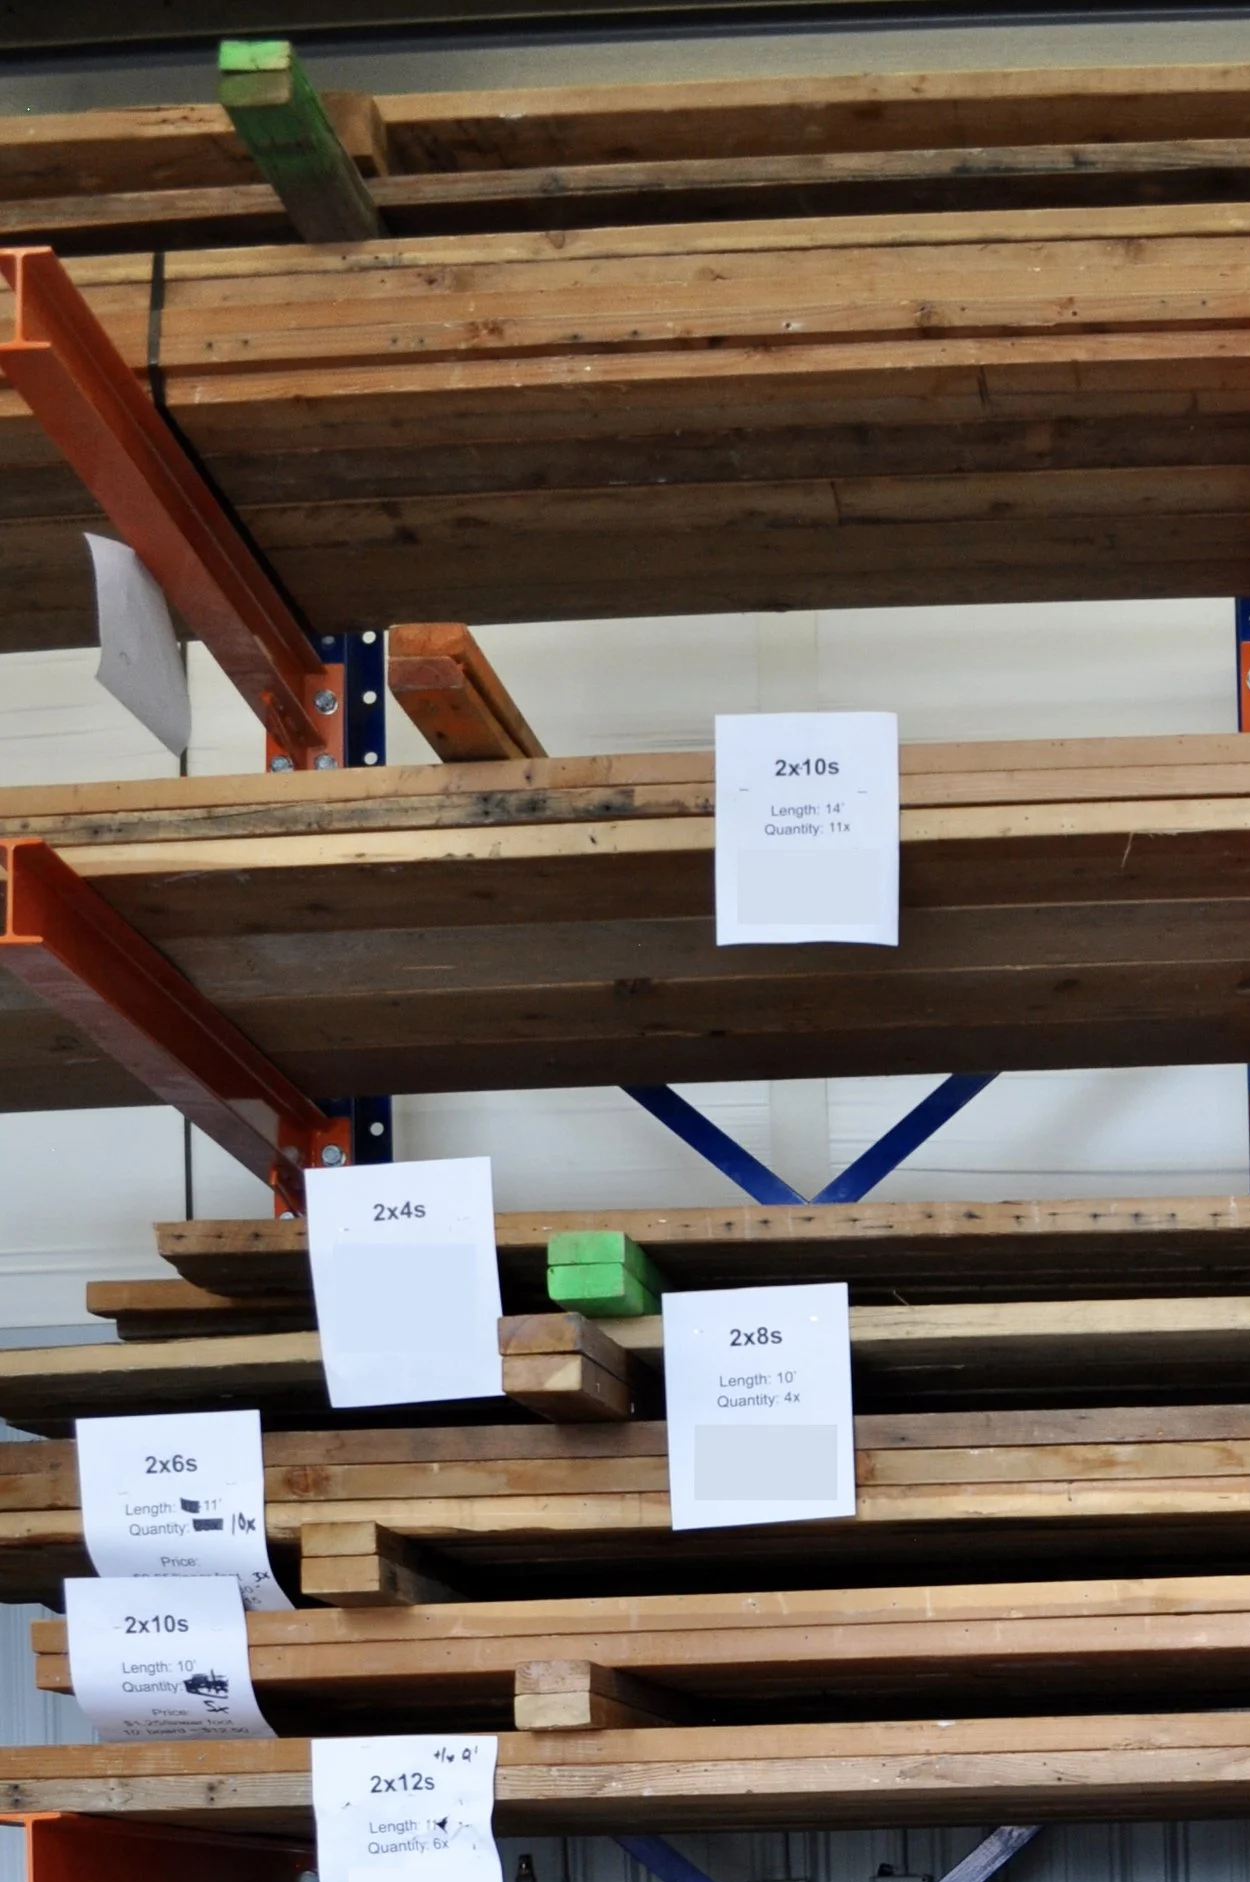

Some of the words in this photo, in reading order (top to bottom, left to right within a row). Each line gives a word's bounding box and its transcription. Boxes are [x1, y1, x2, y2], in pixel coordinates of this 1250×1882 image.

[775, 758, 840, 776] 2x10s
[771, 804, 820, 818] Length:
[764, 824, 824, 836] Quantity:
[830, 822, 851, 833] 11x
[373, 1201, 426, 1221] 2x4s
[730, 1326, 783, 1346] 2x8s
[719, 1373, 772, 1389] Length:
[717, 1394, 779, 1408] Quantity:
[784, 1392, 801, 1404] 4x
[145, 1455, 198, 1474] 2x6s
[125, 1503, 175, 1517] Length:
[129, 1524, 190, 1536] Quantity:
[124, 1615, 189, 1634] 2x10s
[122, 1662, 172, 1676] Length:
[122, 1681, 183, 1694] Quantity:
[371, 1772, 435, 1793] 2x12s
[370, 1820, 421, 1834] Length:
[368, 1839, 429, 1854] Quantity:
[433, 1838, 449, 1850] 6x
